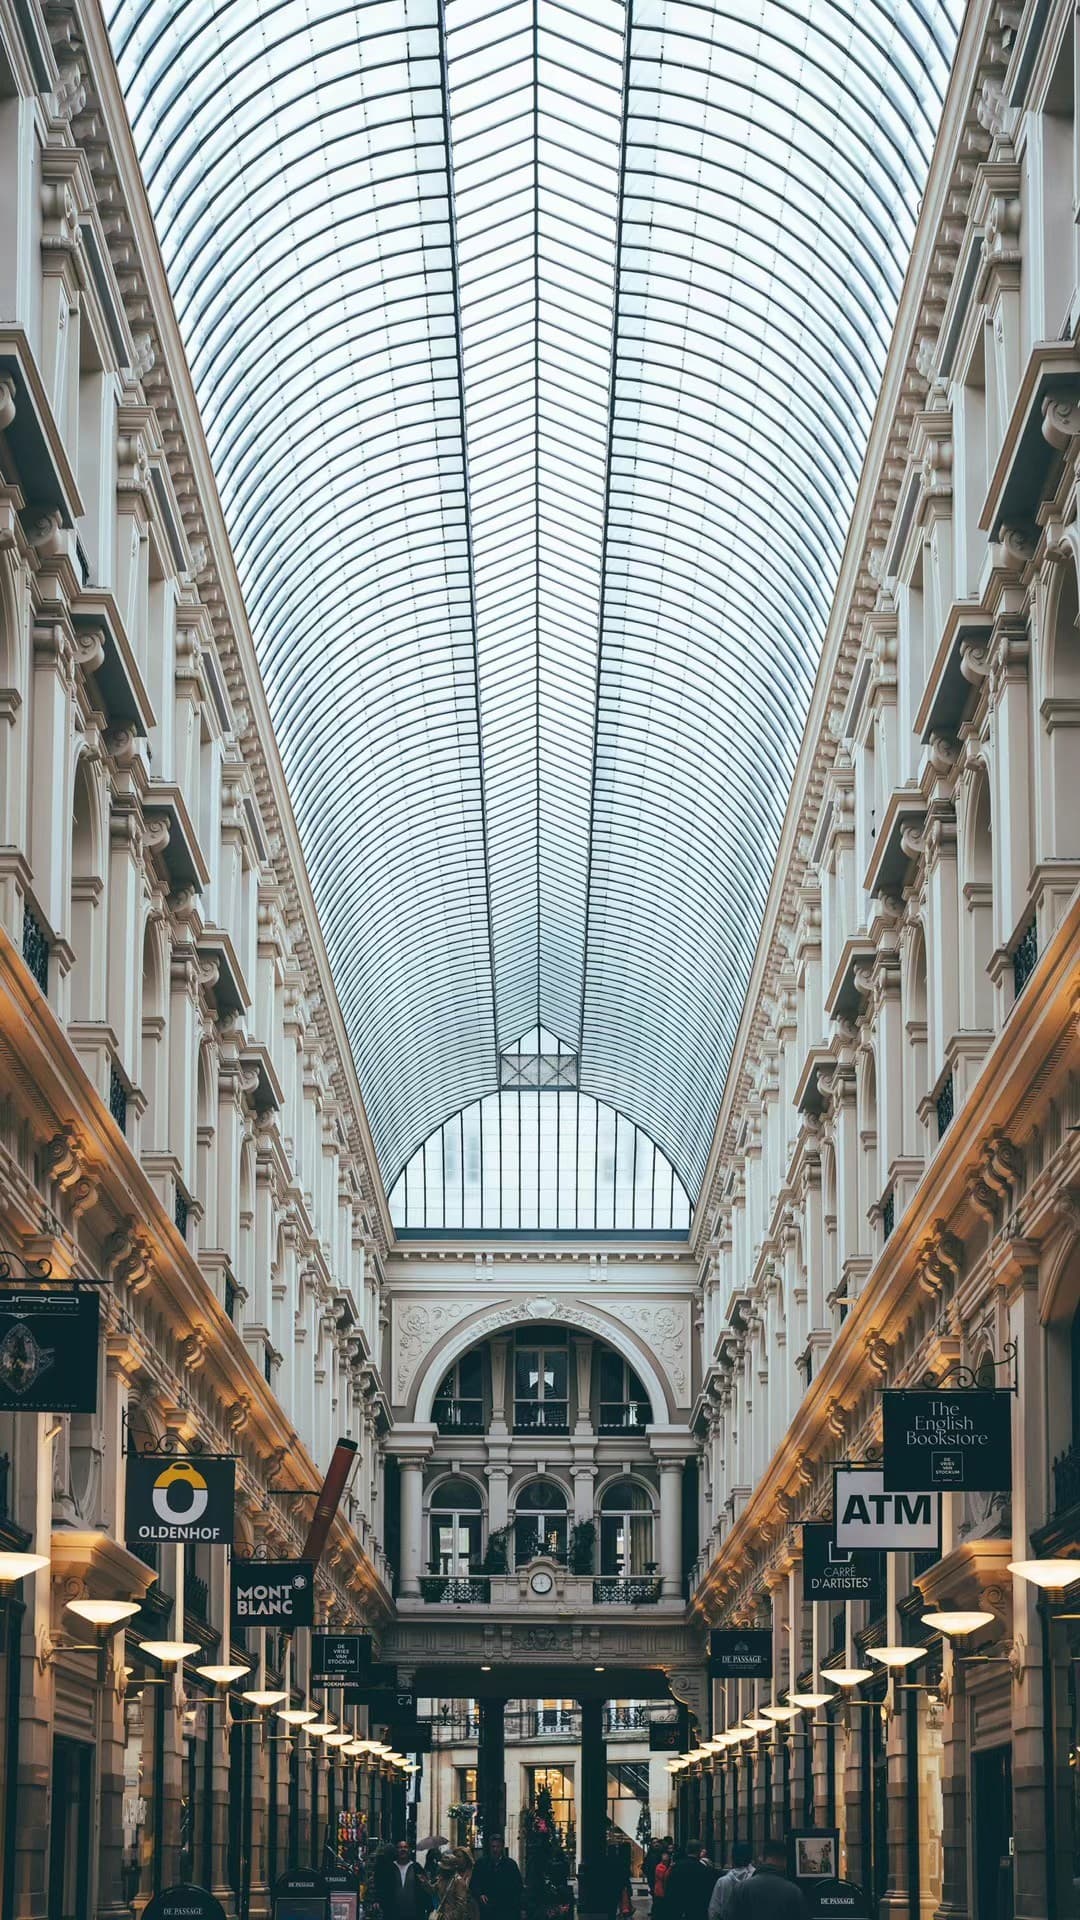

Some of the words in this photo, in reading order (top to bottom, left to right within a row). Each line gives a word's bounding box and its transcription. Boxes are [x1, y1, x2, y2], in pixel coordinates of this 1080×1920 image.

[928, 1401, 960, 1416] The
[915, 1415, 974, 1434] English
[906, 1431, 988, 1446] Bookstore
[841, 1494, 932, 1525] ATM
[138, 1525, 220, 1540] OLDENHOF
[823, 1563, 857, 1577] CARRÉ
[237, 1585, 293, 1600] MONT
[237, 1599, 293, 1615] BLANC
[721, 1655, 732, 1664] DE
[733, 1655, 762, 1664] PASSAGE
[820, 1897, 830, 1905] DE
[830, 1897, 855, 1905] PASSAGE
[163, 1907, 173, 1915] DE
[174, 1907, 203, 1916] PASSAGE
